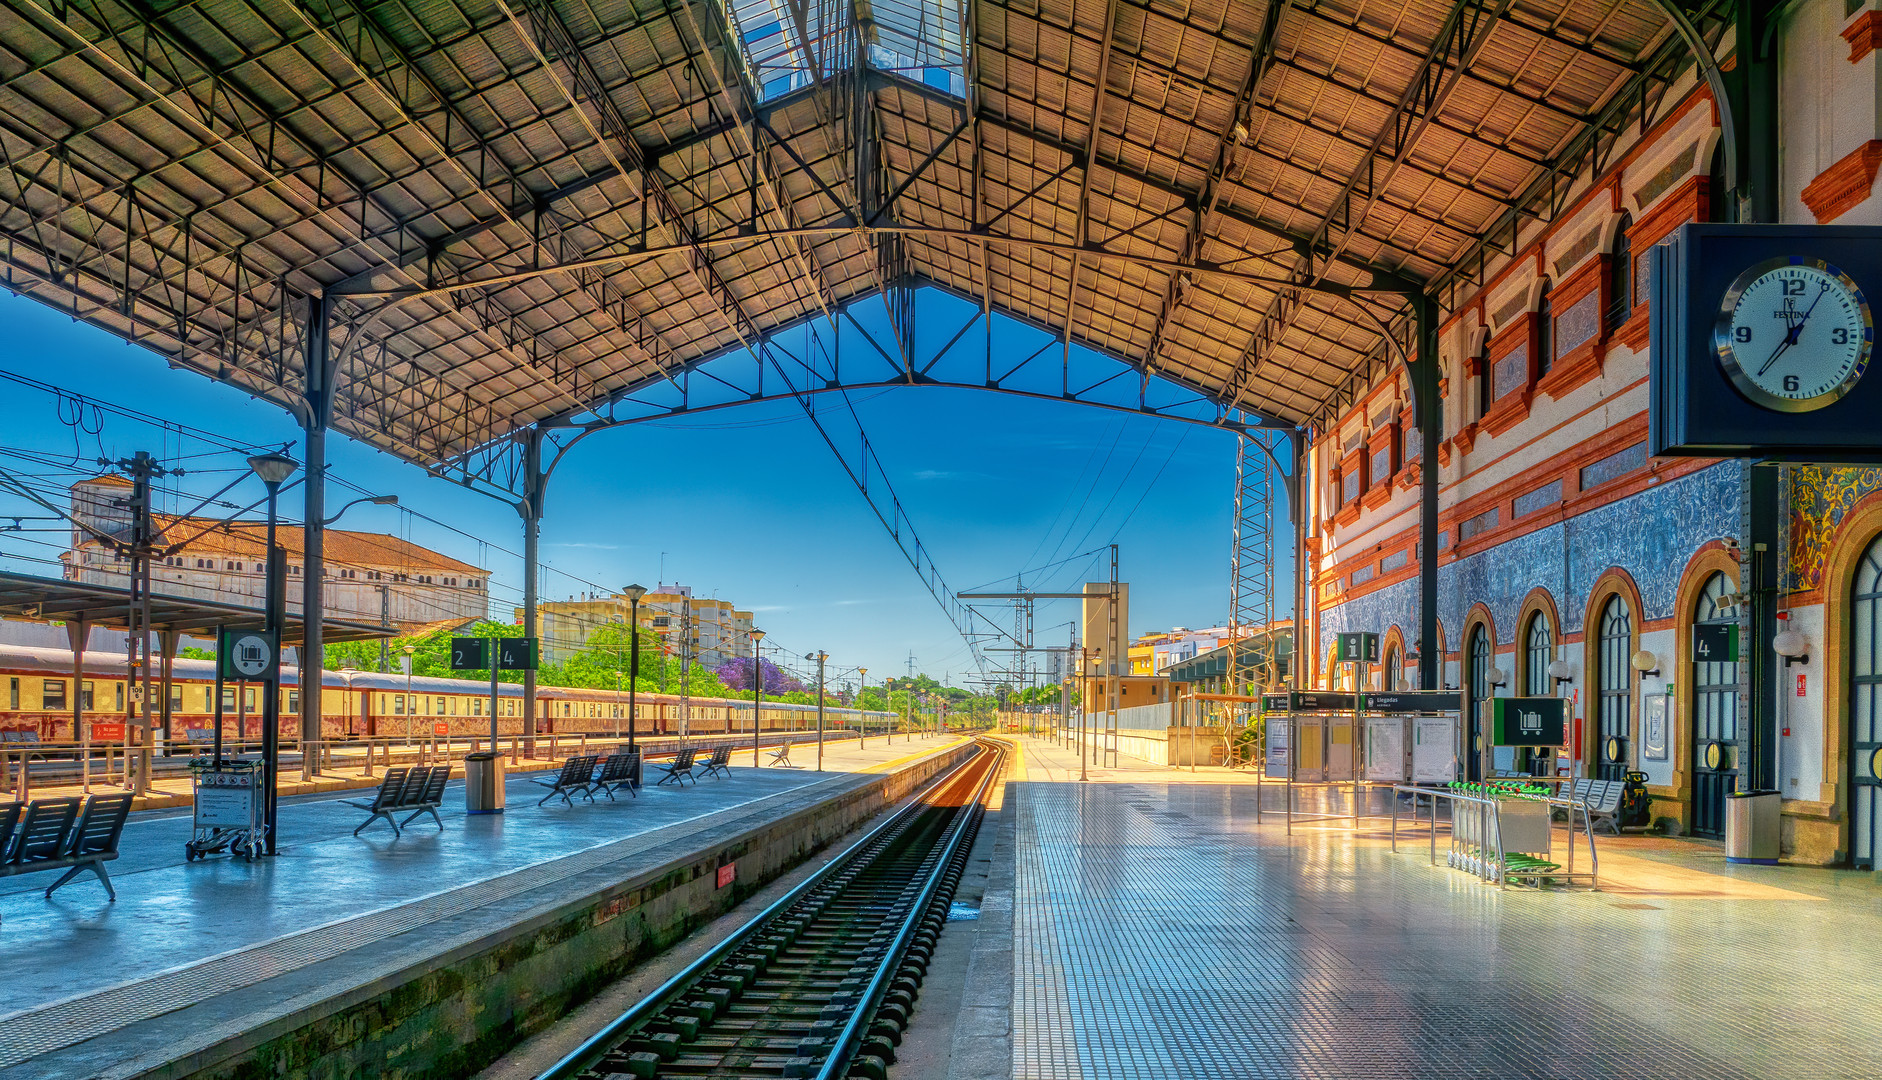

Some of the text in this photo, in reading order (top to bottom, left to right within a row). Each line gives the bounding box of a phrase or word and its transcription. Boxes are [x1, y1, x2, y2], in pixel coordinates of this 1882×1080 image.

[1779, 279, 1805, 295] 12
[1736, 327, 1751, 343] 9
[1832, 328, 1848, 344] 3
[1783, 375, 1799, 391] 6
[1698, 639, 1710, 657] 4
[455, 650, 463, 666] 2
[504, 650, 514, 666] 4
